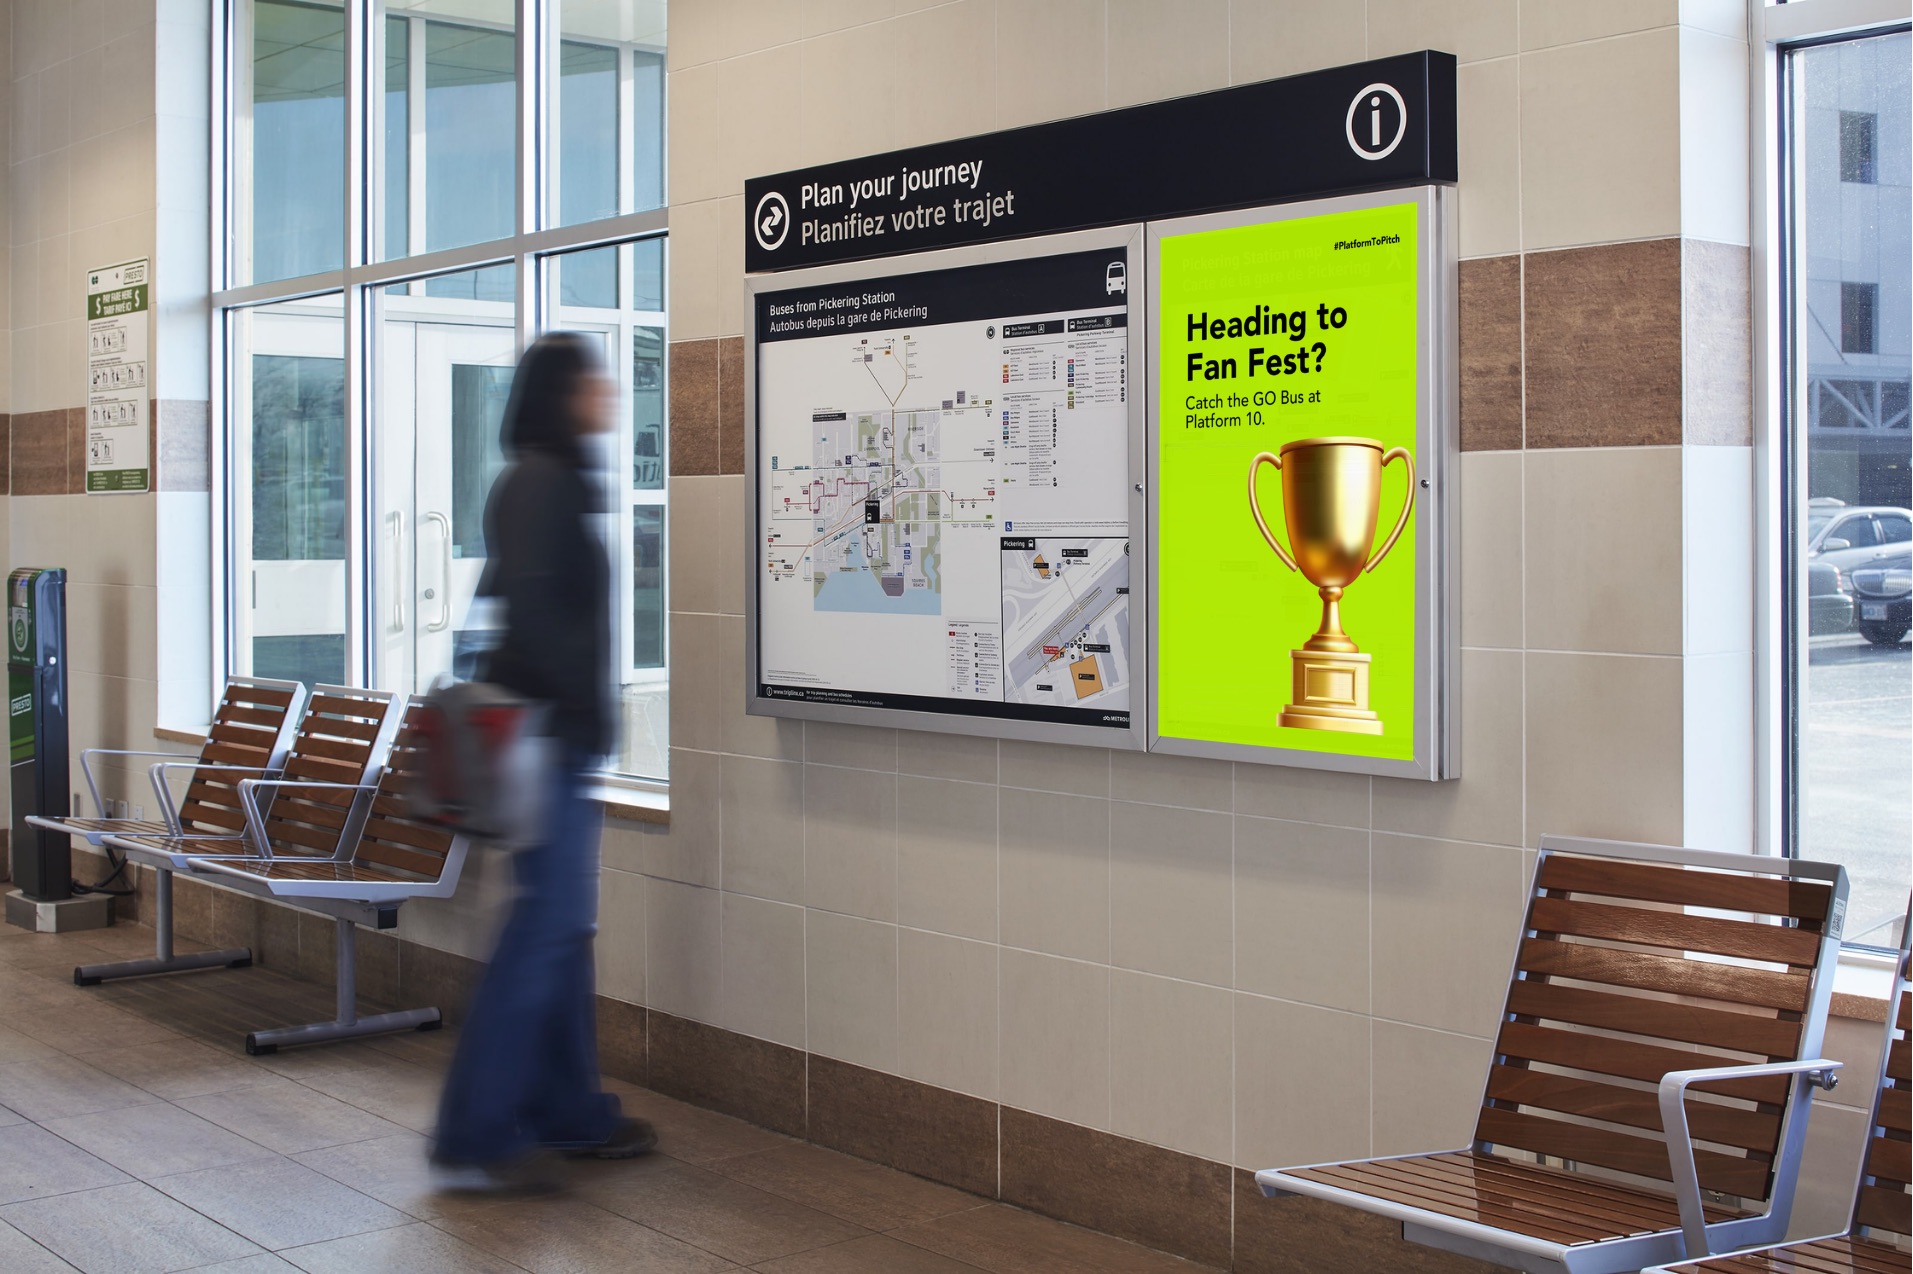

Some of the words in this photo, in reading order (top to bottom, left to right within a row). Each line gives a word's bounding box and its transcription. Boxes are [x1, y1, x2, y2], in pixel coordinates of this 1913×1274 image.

[801, 182, 843, 209] Plan
[849, 174, 895, 208] your
[899, 159, 983, 201] journey
[801, 214, 885, 246] Planifiez
[891, 204, 946, 232] votre
[953, 190, 1015, 227] trajet
[1333, 234, 1401, 250] #PlatformToPitch
[102, 293, 110, 304] PAY
[111, 290, 121, 303] FARE
[122, 289, 132, 300] HERE
[769, 304, 795, 316] Buses
[796, 301, 817, 313] from
[818, 295, 860, 311] Pickering
[862, 291, 895, 306] Station
[103, 304, 115, 316] TARIF
[769, 318, 804, 333] Autobus
[806, 314, 835, 331] depuis
[836, 313, 846, 326] la
[847, 312, 868, 328] gare
[870, 309, 882, 322] de
[884, 305, 928, 320] Pickering
[1187, 304, 1307, 342] Heading
[1316, 303, 1348, 330] to
[1187, 352, 1237, 382] Fan
[1248, 341, 1327, 378] Fest?
[1185, 393, 1224, 410] Catch
[1227, 392, 1249, 408] the
[1252, 390, 1276, 406] GO
[1280, 390, 1304, 406] Bus
[1308, 389, 1322, 404] at
[1185, 412, 1242, 430] Platform
[1246, 411, 1266, 426] 10.
[1004, 540, 1025, 549] Pickering
[13, 698, 30, 712] PRESTO
